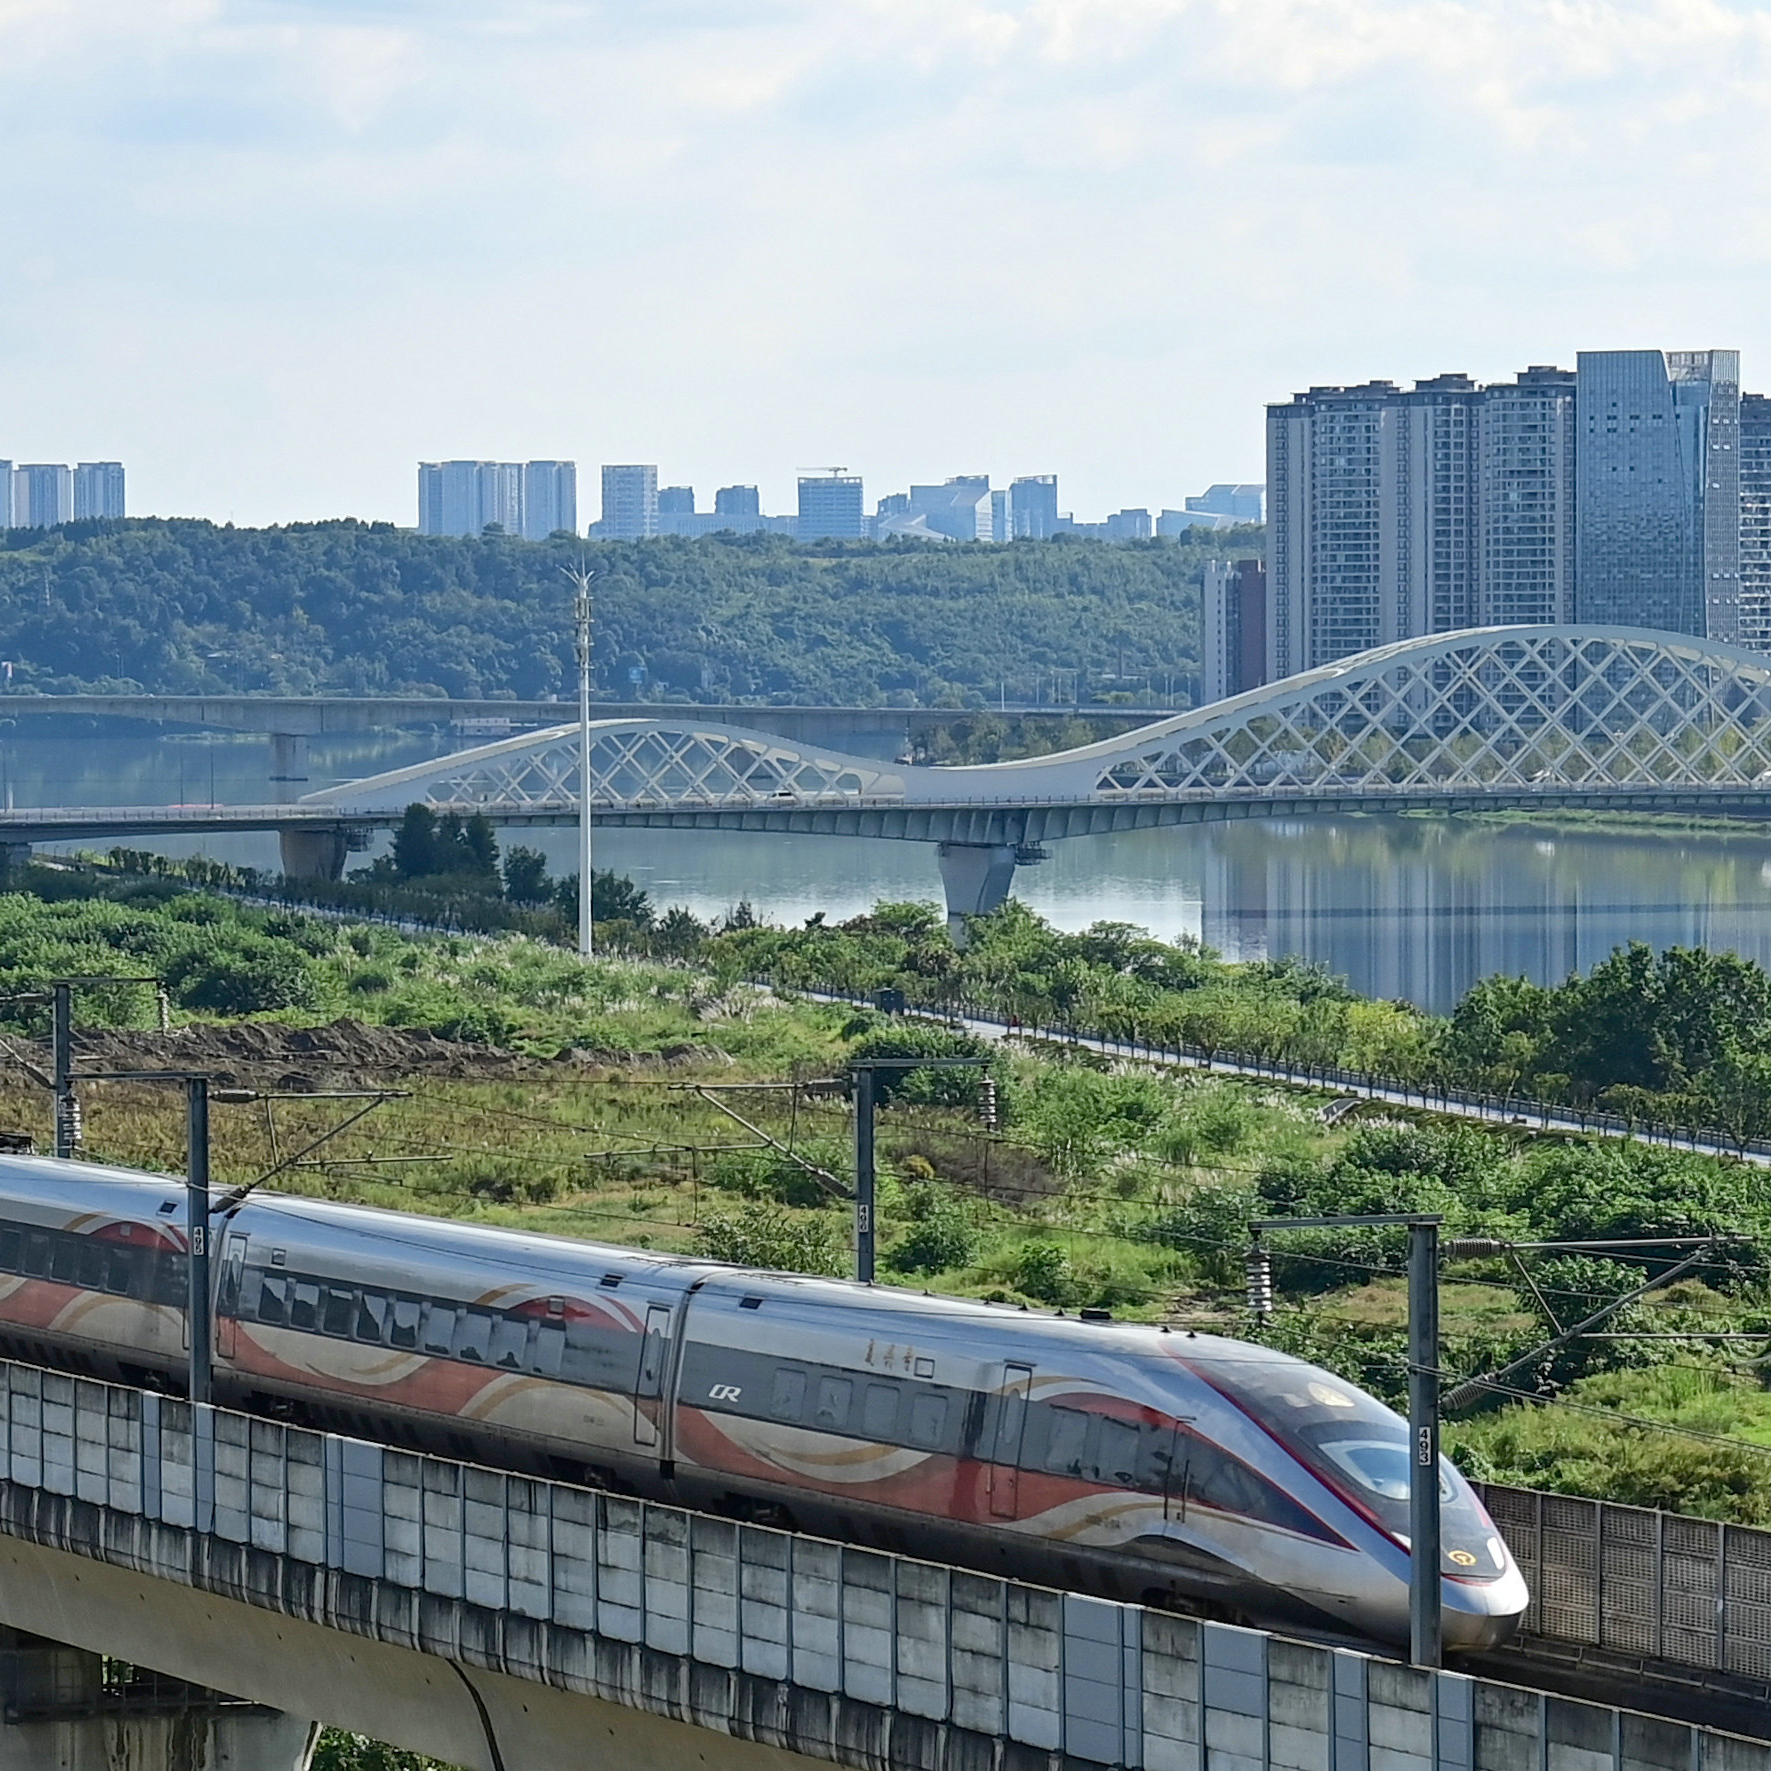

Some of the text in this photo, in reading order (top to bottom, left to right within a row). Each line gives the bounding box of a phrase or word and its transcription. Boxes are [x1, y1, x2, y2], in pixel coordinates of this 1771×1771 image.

[194, 1228, 203, 1254] 495
[708, 1383, 742, 1403] CR
[1420, 1429, 1429, 1463] 493
